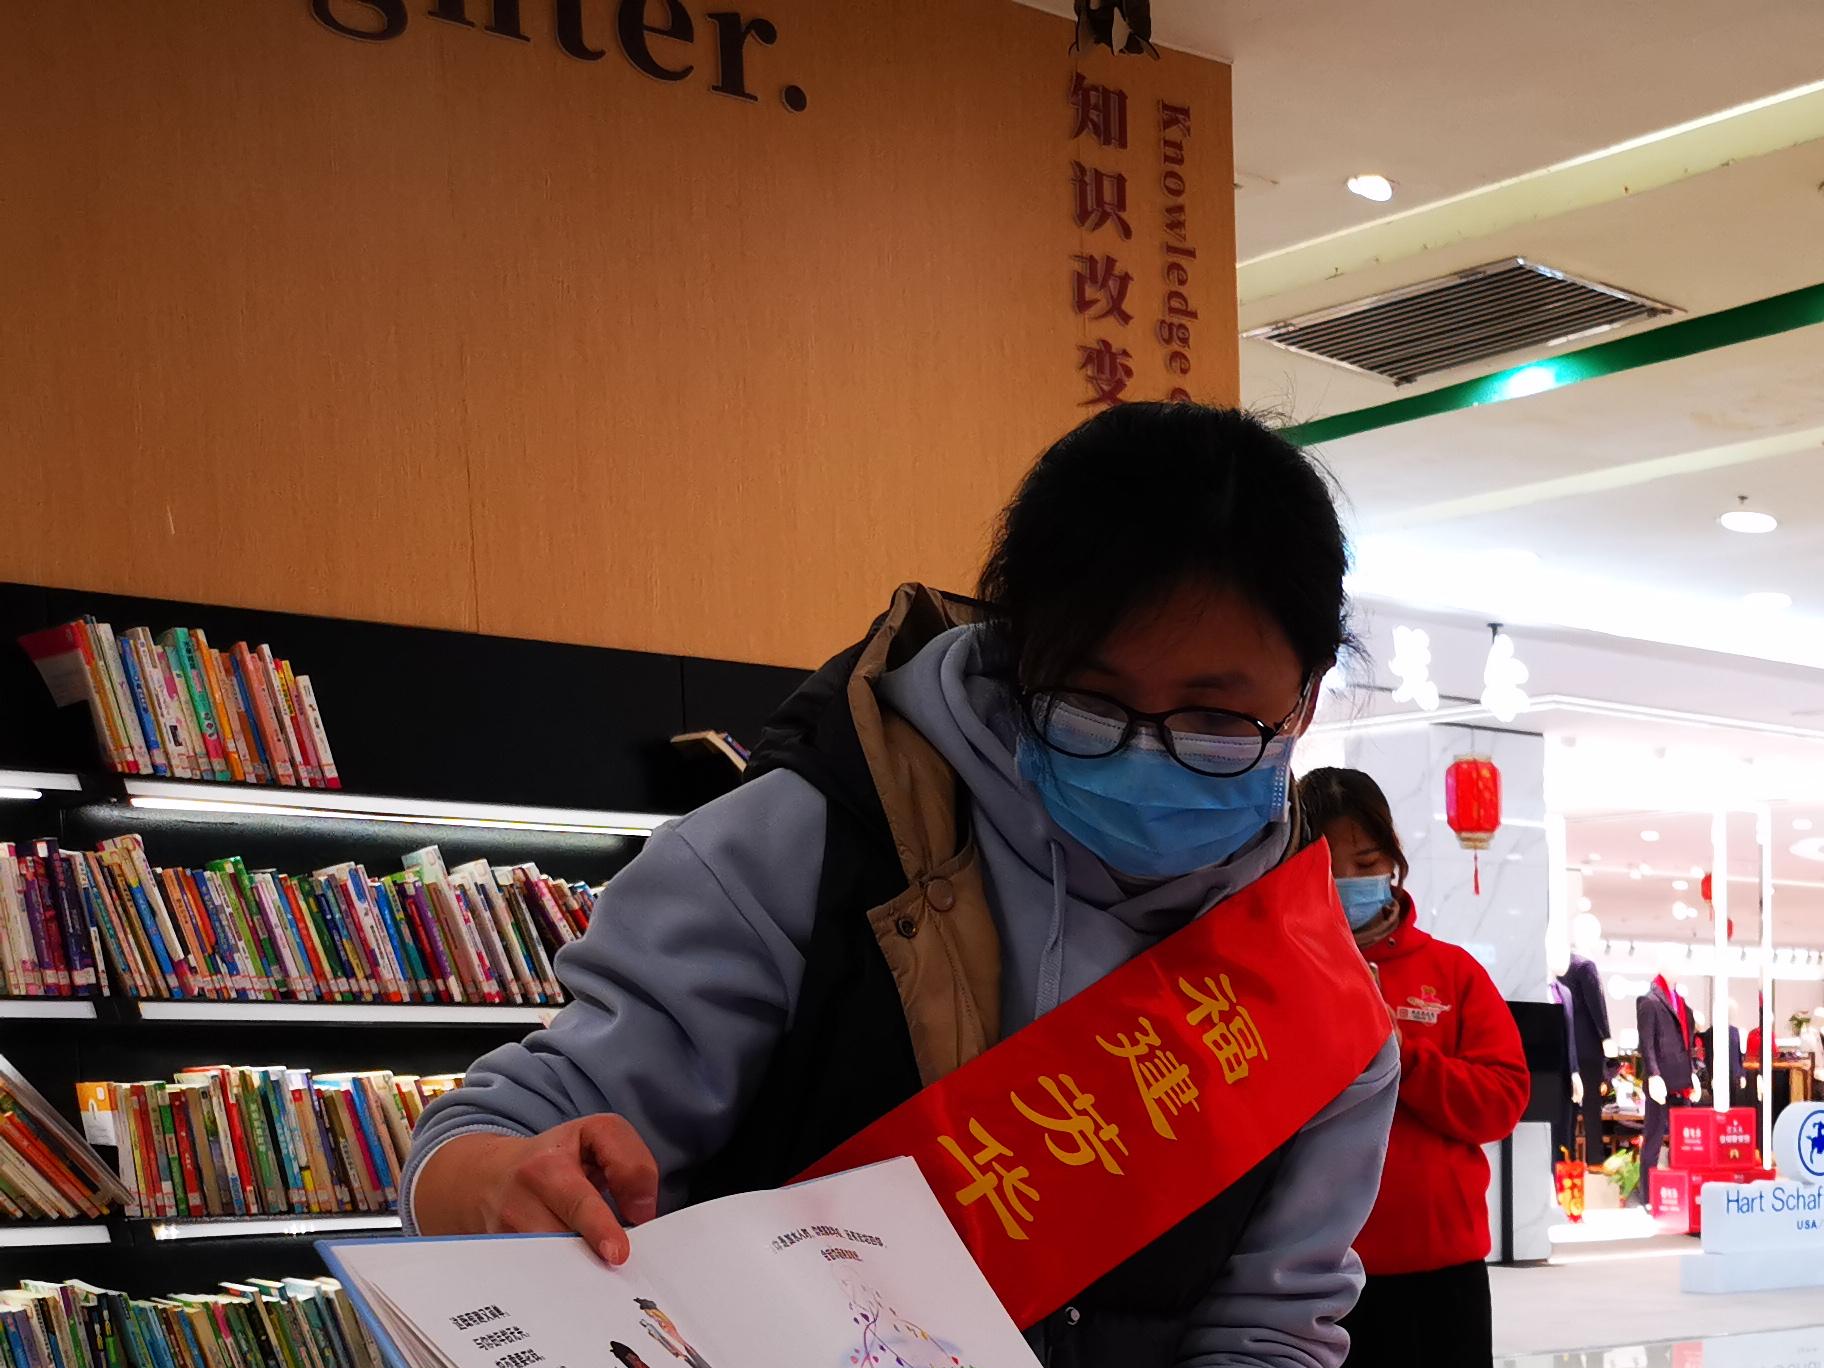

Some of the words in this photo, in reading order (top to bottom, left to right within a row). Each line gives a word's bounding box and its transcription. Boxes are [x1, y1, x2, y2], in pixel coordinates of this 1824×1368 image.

[311, 0, 808, 113] ter.
[1069, 71, 1135, 406] 知识改变
[1158, 98, 1198, 376] Knowledge
[1725, 1189, 1765, 1215] Hart
[1796, 1218, 1818, 1230] USA
